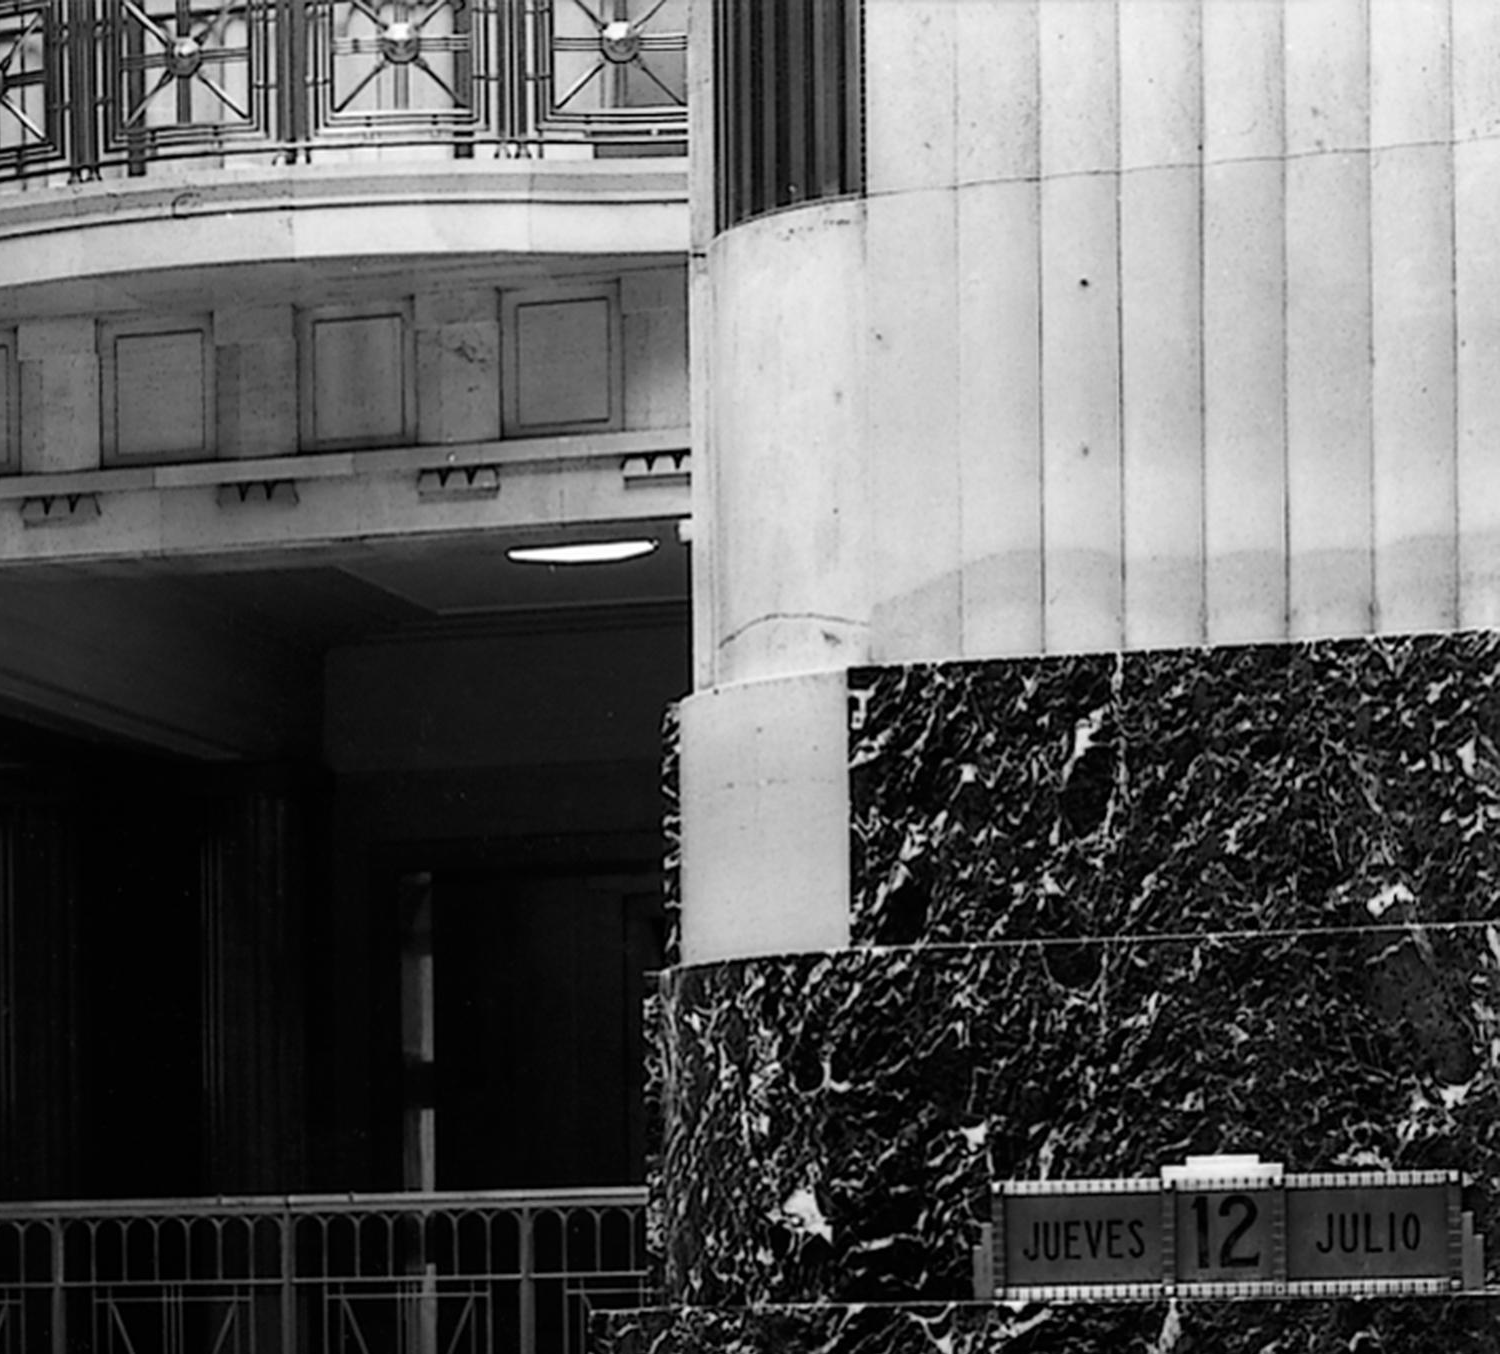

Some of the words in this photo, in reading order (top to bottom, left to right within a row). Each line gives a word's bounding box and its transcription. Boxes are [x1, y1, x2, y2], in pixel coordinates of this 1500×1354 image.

[1023, 1218, 1146, 1262] JUEVES
[1190, 1195, 1260, 1269] 12
[1316, 1211, 1422, 1255] JULIO
